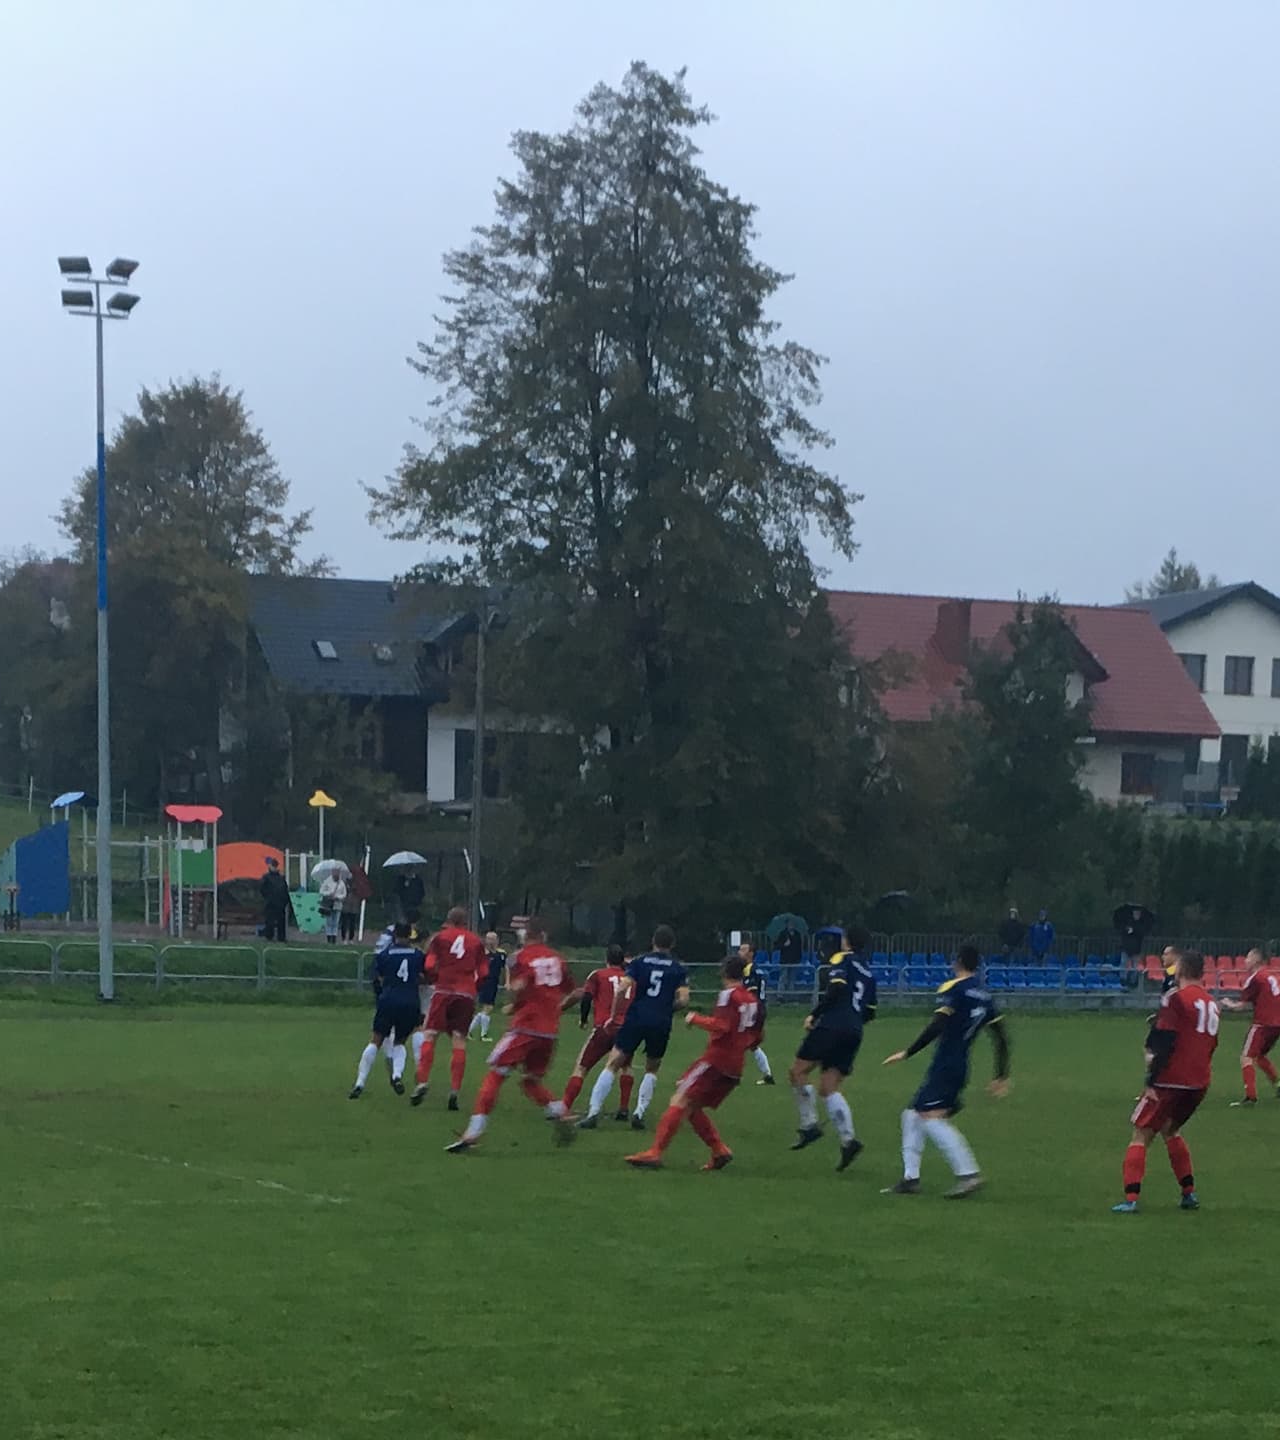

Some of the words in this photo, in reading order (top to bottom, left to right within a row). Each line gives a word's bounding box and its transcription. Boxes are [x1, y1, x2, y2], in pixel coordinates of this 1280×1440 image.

[450, 934, 466, 959] 4
[396, 959, 409, 982] 4
[647, 970, 664, 997] 5
